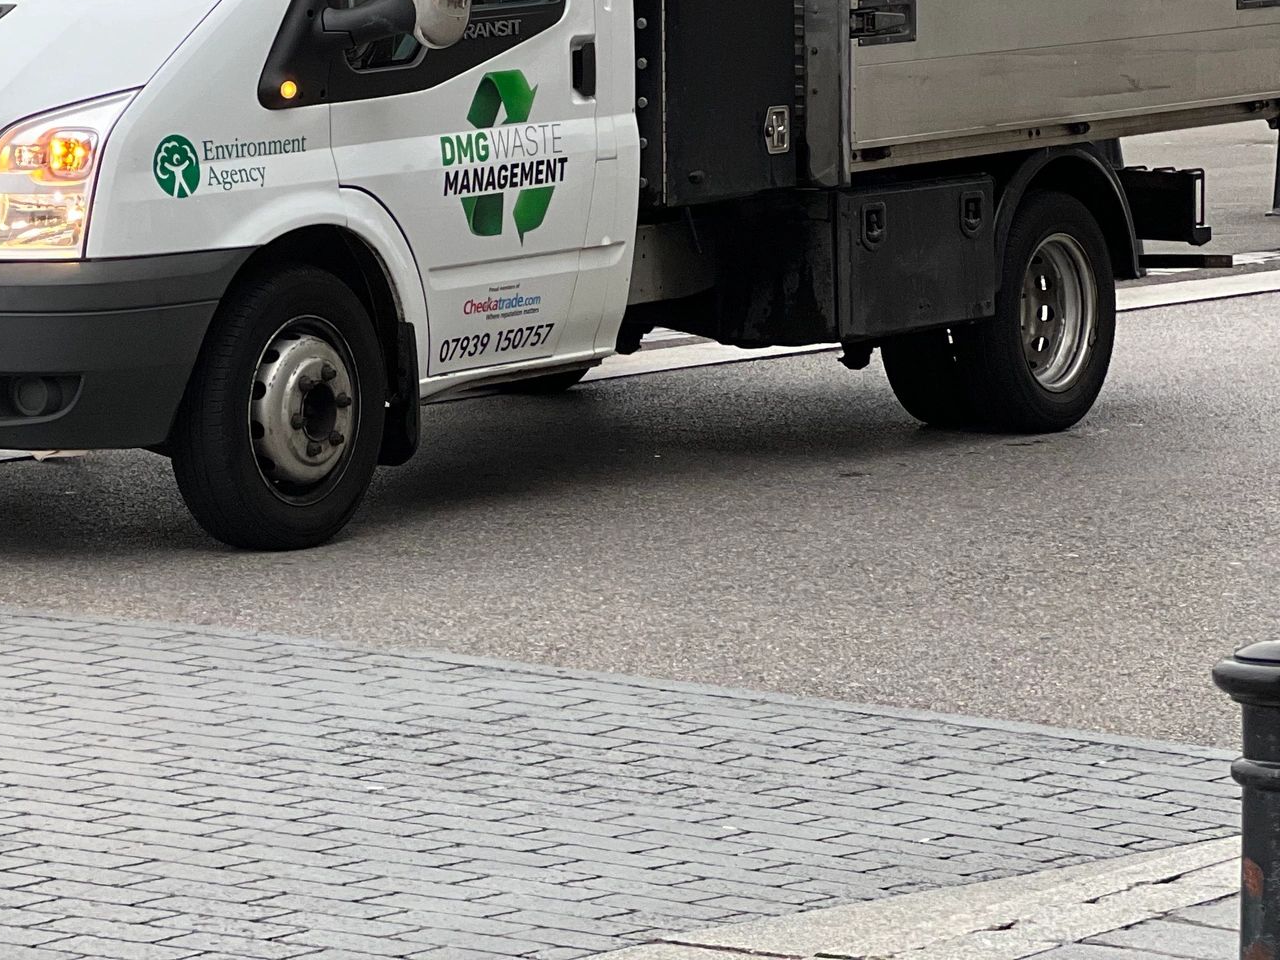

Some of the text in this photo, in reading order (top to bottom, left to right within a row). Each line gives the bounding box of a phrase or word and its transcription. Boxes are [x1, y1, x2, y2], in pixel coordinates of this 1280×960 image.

[464, 19, 521, 39] RANSIT
[202, 135, 307, 162] Environment
[440, 123, 563, 167] DMG WASTE
[207, 166, 266, 191] Agency
[443, 156, 568, 197] MANAGEMENT
[463, 292, 541, 315] Checkatrade.com
[439, 322, 555, 363] 07939 150757
